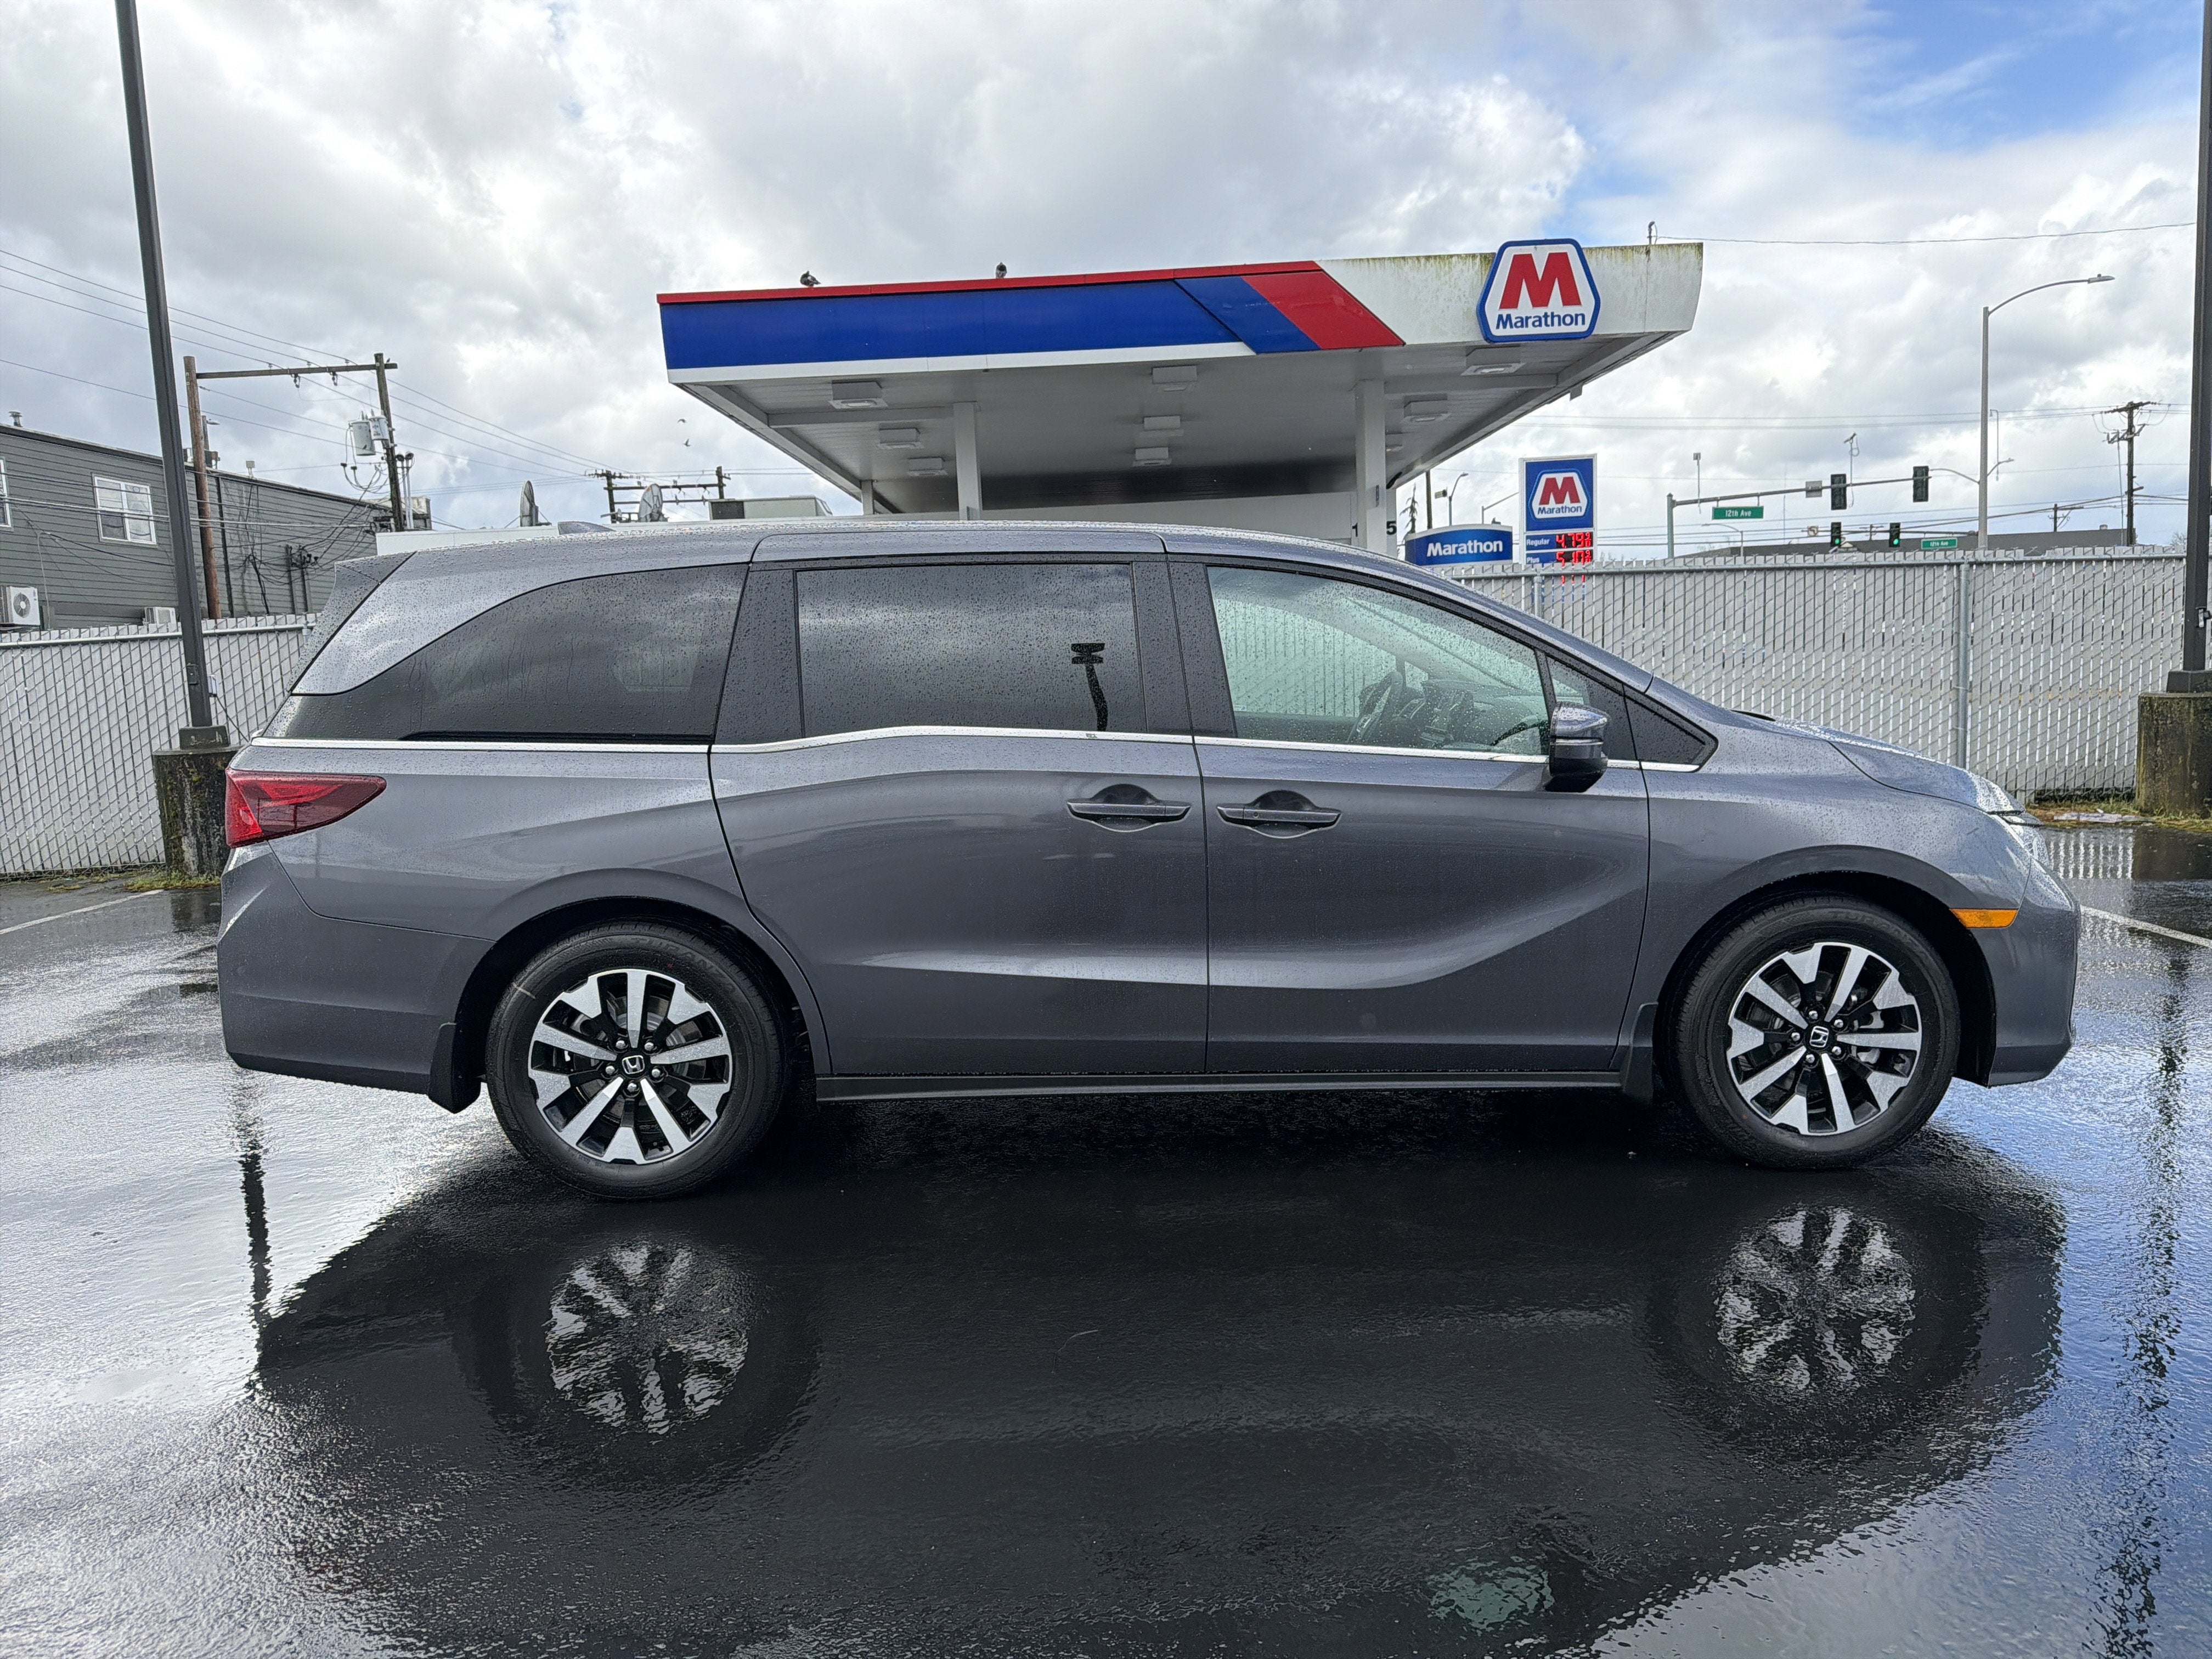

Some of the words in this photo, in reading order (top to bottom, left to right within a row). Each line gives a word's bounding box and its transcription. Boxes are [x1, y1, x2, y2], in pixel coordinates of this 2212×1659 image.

[1499, 252, 1582, 310] M
[1496, 312, 1585, 330] Marathon
[1537, 505, 1582, 515] Marathon
[1426, 539, 1503, 557] Marathon
[1526, 538, 1550, 546] Regular
